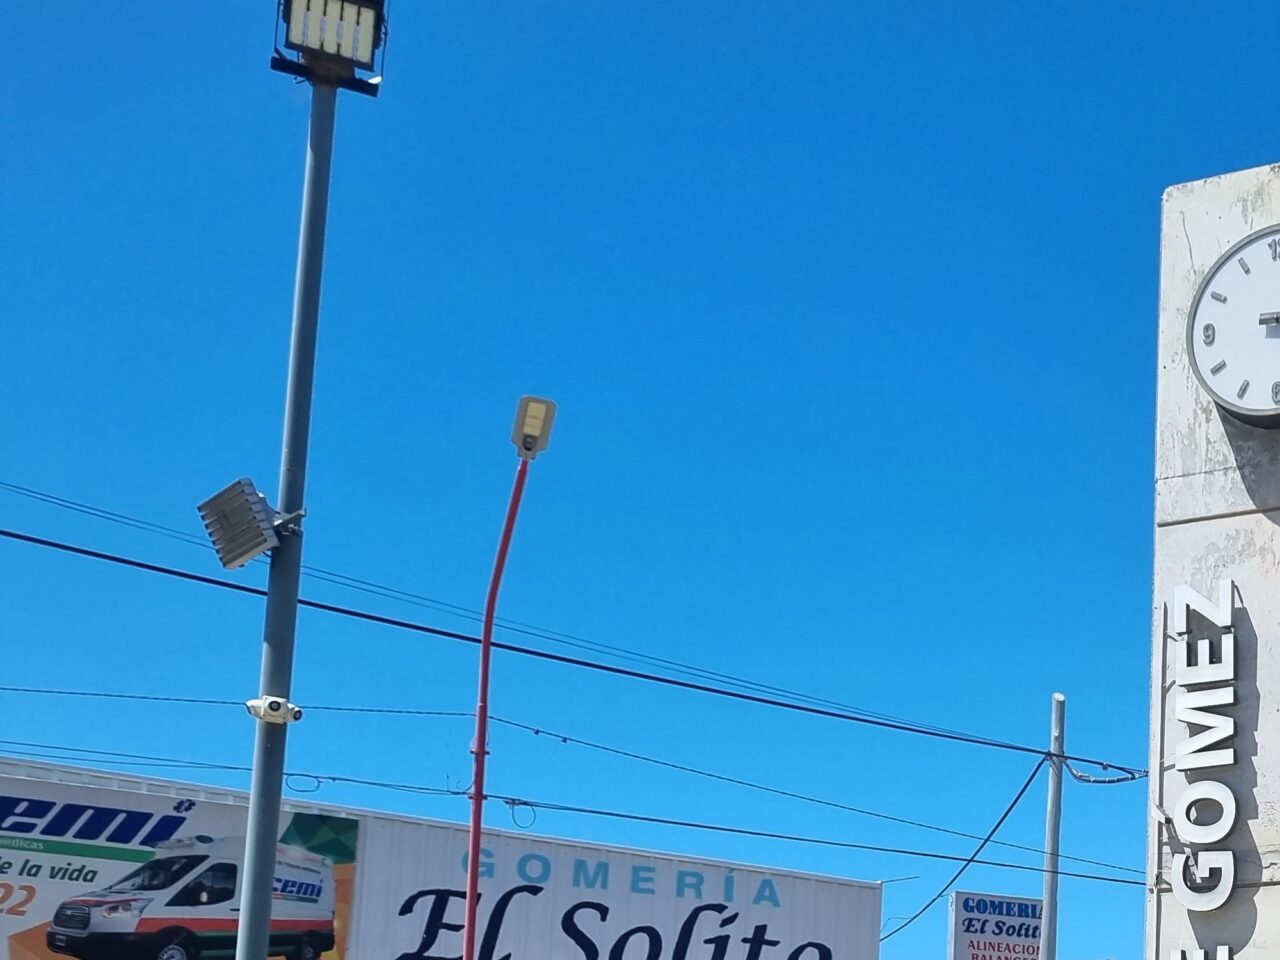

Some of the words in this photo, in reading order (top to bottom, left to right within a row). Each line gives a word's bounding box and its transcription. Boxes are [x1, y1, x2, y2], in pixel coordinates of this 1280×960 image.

[1202, 323, 1216, 347] 9
[0, 857, 12, 875] e
[18, 859, 43, 878] la
[49, 863, 98, 883] vida
[461, 847, 781, 909] GOMERÍA
[962, 917, 989, 935] El
[992, 919, 1041, 940] Solit
